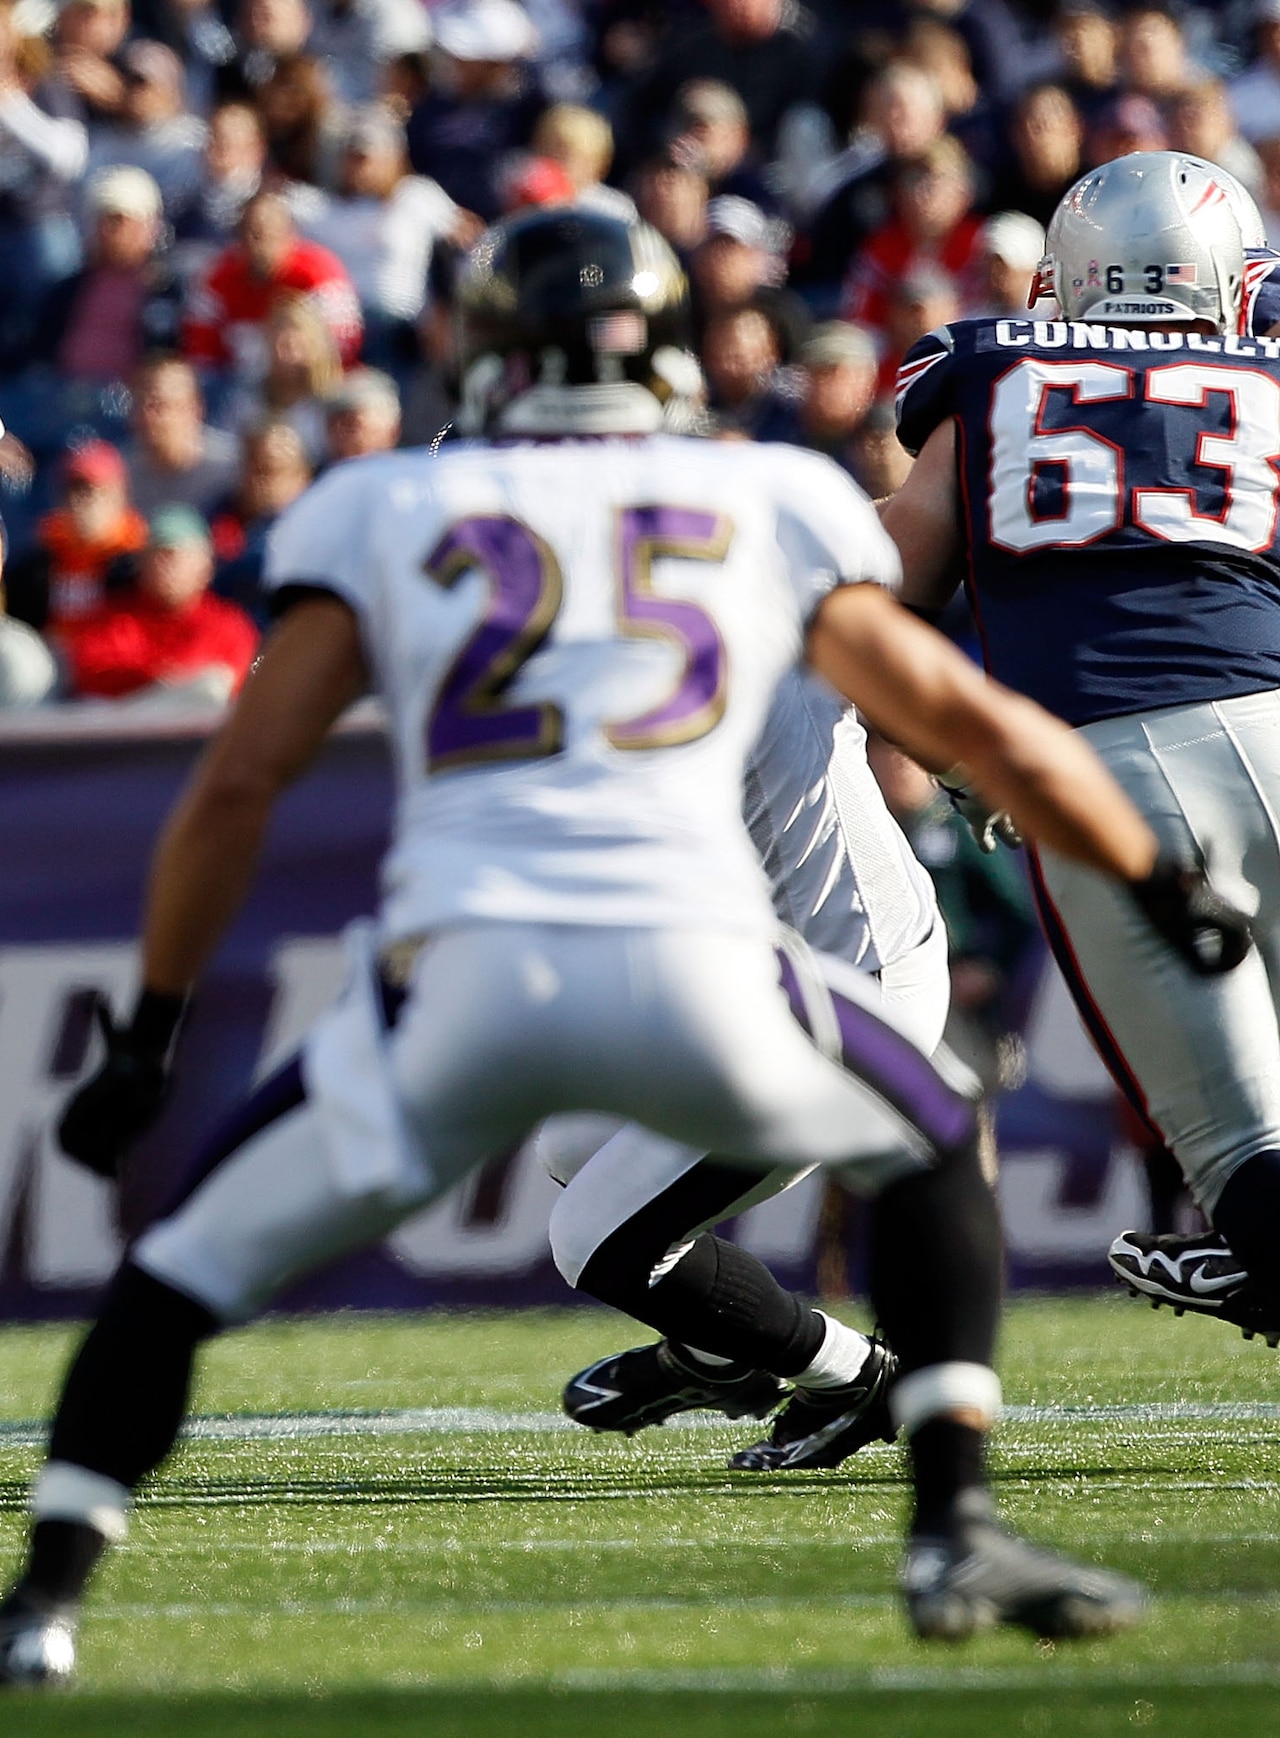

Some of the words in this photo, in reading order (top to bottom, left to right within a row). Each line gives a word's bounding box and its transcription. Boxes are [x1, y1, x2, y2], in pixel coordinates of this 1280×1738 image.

[1104, 302, 1175, 314] PATRIOTS
[986, 356, 1280, 556] 63
[420, 503, 734, 775] 25
